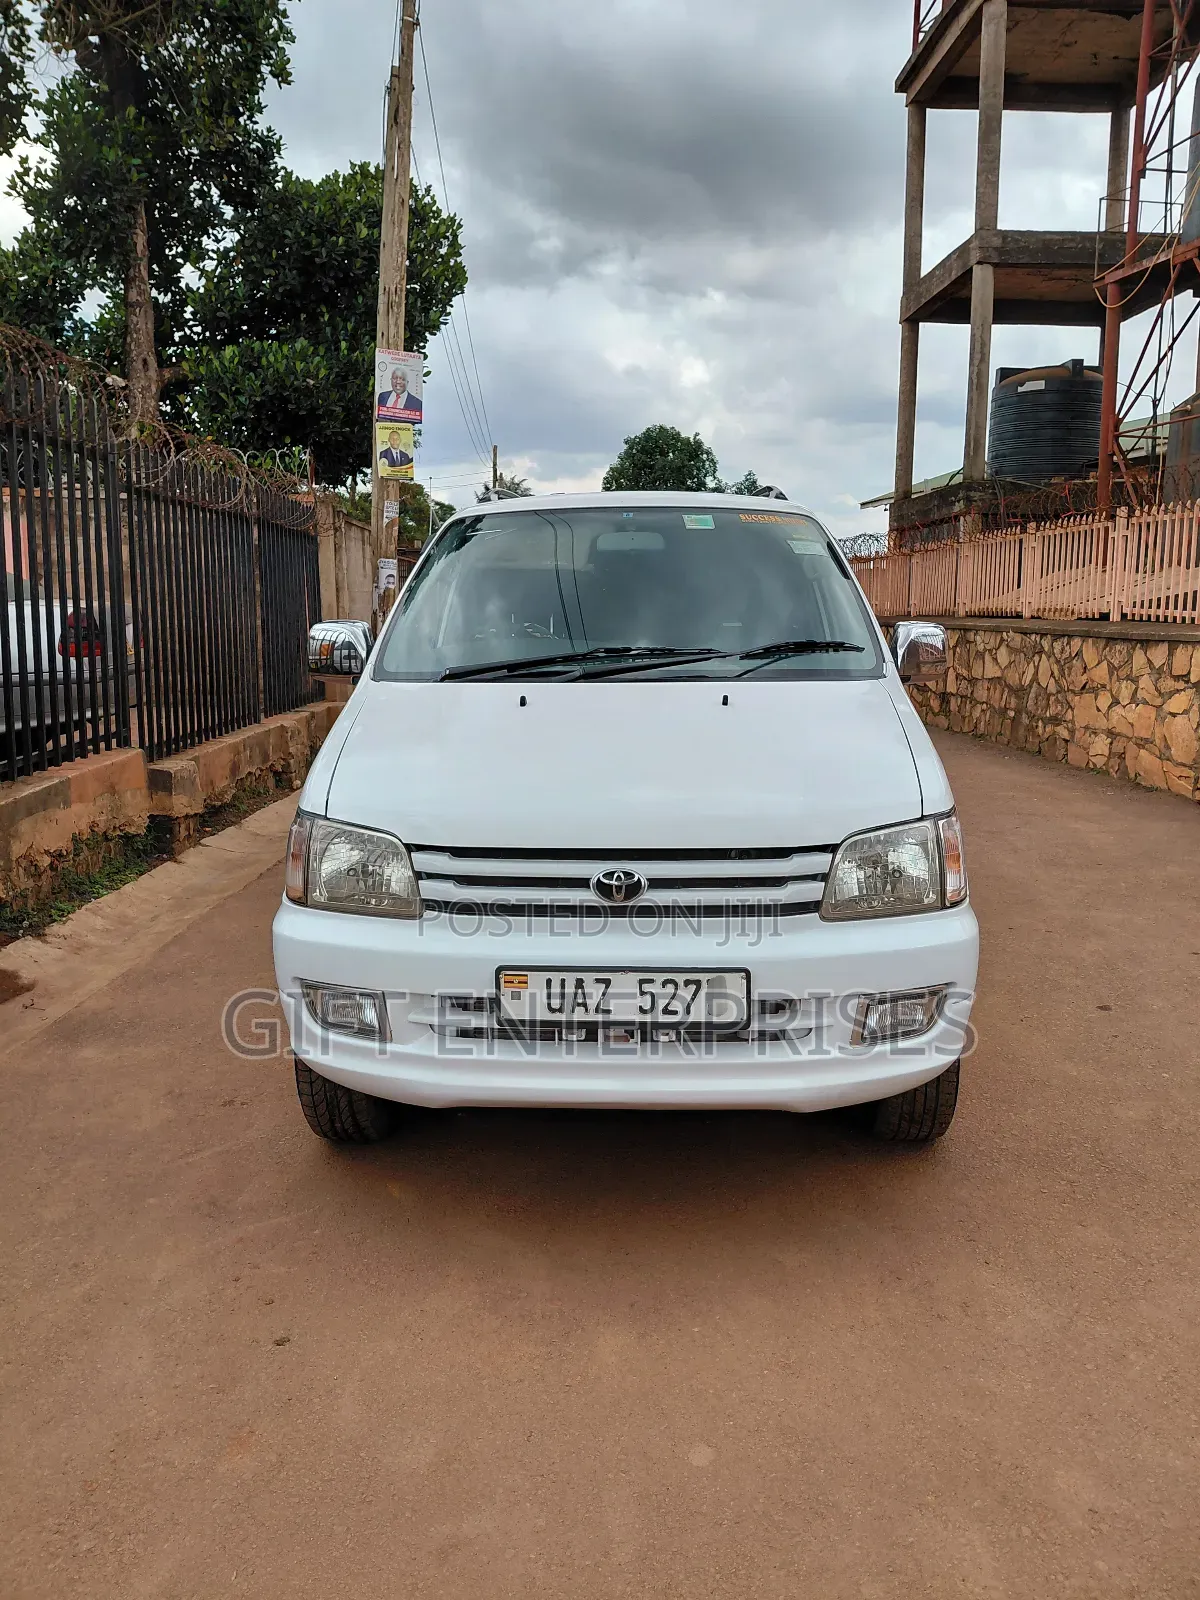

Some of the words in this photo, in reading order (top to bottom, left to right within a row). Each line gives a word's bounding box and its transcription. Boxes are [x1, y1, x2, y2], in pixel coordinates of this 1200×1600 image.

[739, 513, 782, 522] SUCCESS
[545, 977, 613, 1015] UAZ
[637, 977, 727, 1016] 527
